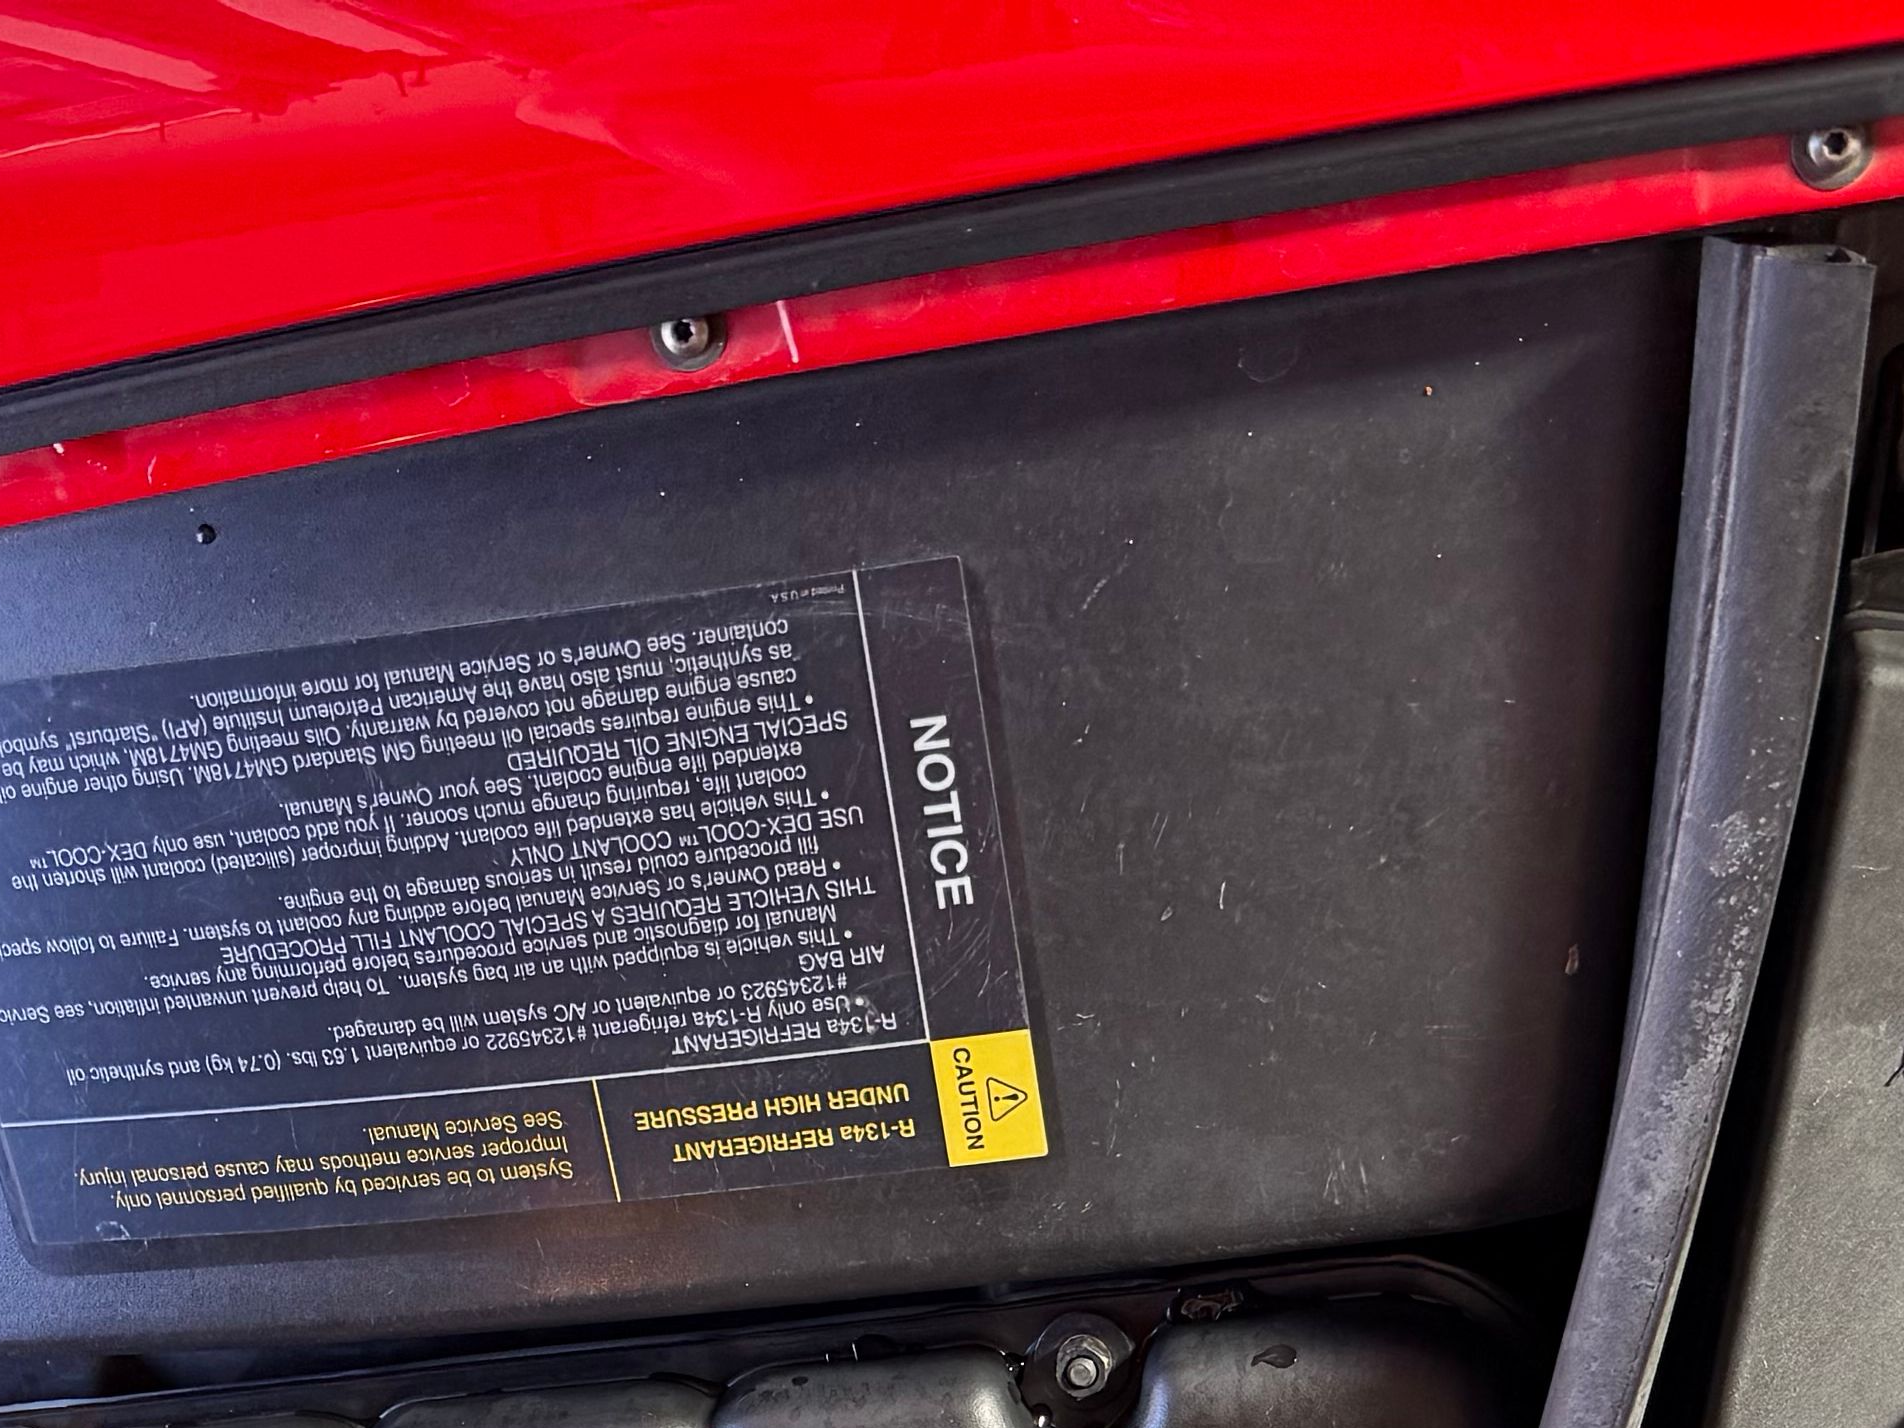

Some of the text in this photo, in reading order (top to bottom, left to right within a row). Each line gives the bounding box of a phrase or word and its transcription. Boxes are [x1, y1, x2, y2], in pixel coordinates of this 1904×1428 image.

[506, 709, 848, 771] SPECIAL ENGINE OIL REQUIRED
[510, 804, 864, 867] USE DEX-COOL™ COOLANT ONLY
[908, 714, 975, 910] NOTICE
[217, 875, 876, 967] THIS VEHICLE REQUIRES A SPECIAL COOLANT FILL PROCEDURE
[797, 943, 884, 972] AIR BAG
[671, 1011, 897, 1055] R-134a REFRIGERANT
[362, 1110, 564, 1145] See Service Manual.
[634, 1082, 910, 1130] UNDER HIGH PRESSURE
[951, 1046, 984, 1151] CAUTION
[72, 1132, 568, 1193] Improper service methods may cause personal injury.
[672, 1117, 915, 1162] R-134a REFRIGERANT
[110, 1156, 573, 1212] System to be serviced by qualified personnel only.
